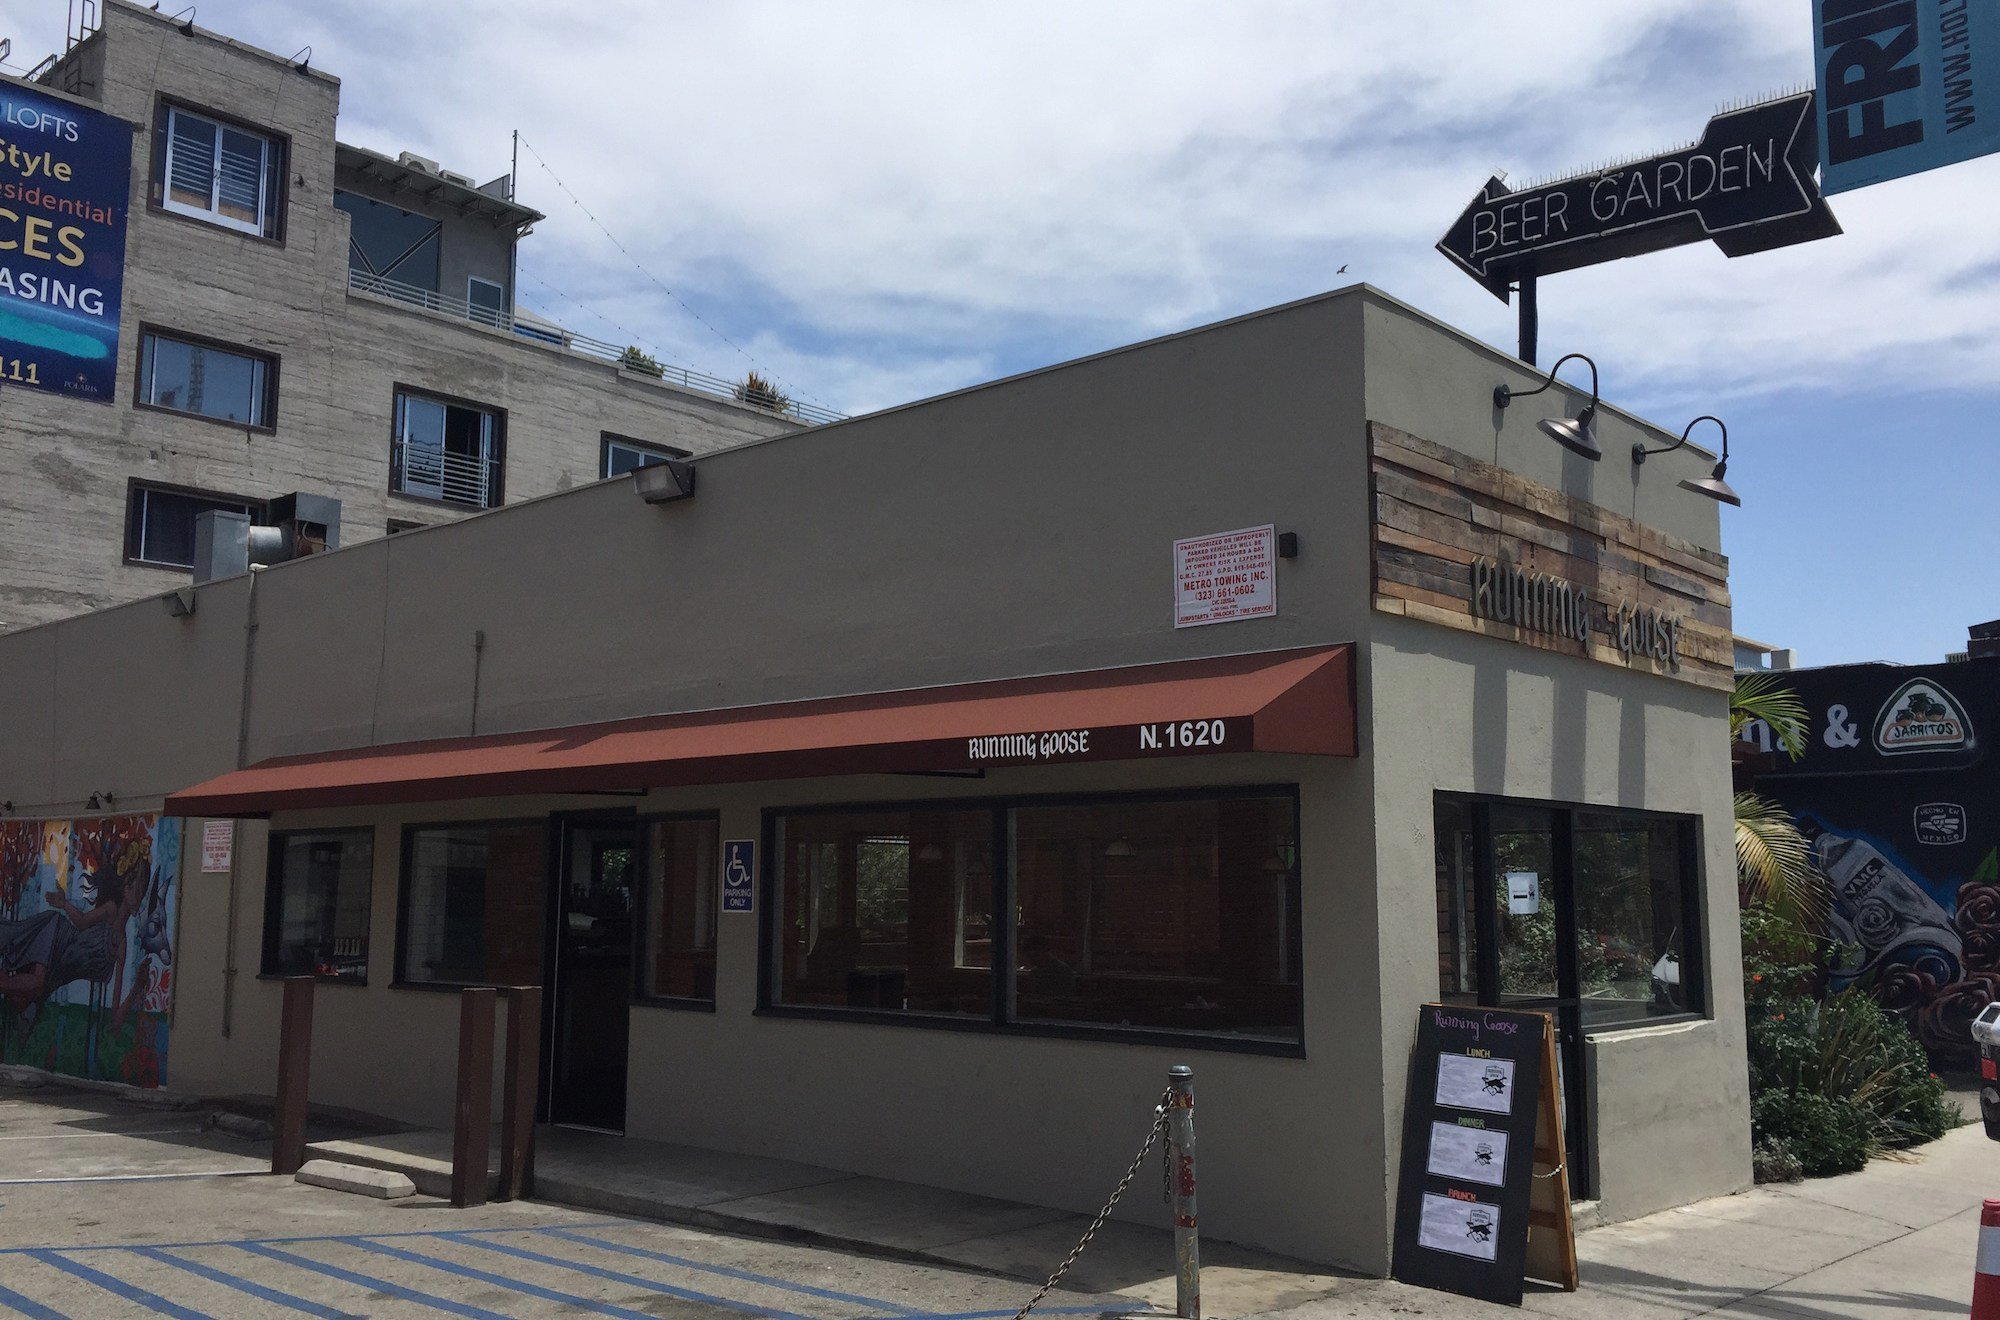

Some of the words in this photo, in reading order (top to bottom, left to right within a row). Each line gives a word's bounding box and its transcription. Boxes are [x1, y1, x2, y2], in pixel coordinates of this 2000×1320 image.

[1938, 0, 1976, 135] WWW.HOL
[7, 102, 79, 142] LOFTS
[1469, 191, 1569, 258] BEER
[1590, 137, 1774, 222] GARDEN
[1184, 579, 1211, 591] METRO
[1215, 574, 1247, 586] TOWING
[1250, 570, 1268, 581] INC.
[1195, 590, 1214, 601] (323)
[1822, 703, 1860, 748] &
[1893, 724, 1955, 738] JARRITOS
[968, 733, 1037, 760] RUNNING
[1040, 729, 1090, 759] GOOSE
[725, 888, 752, 898] PARKING
[729, 897, 746, 907] ONLY
[1434, 1009, 1480, 1042] Running
[1483, 1012, 1518, 1035] Goose
[1457, 1116, 1486, 1130] DINNER
[1447, 1188, 1477, 1202] BRUNCH
